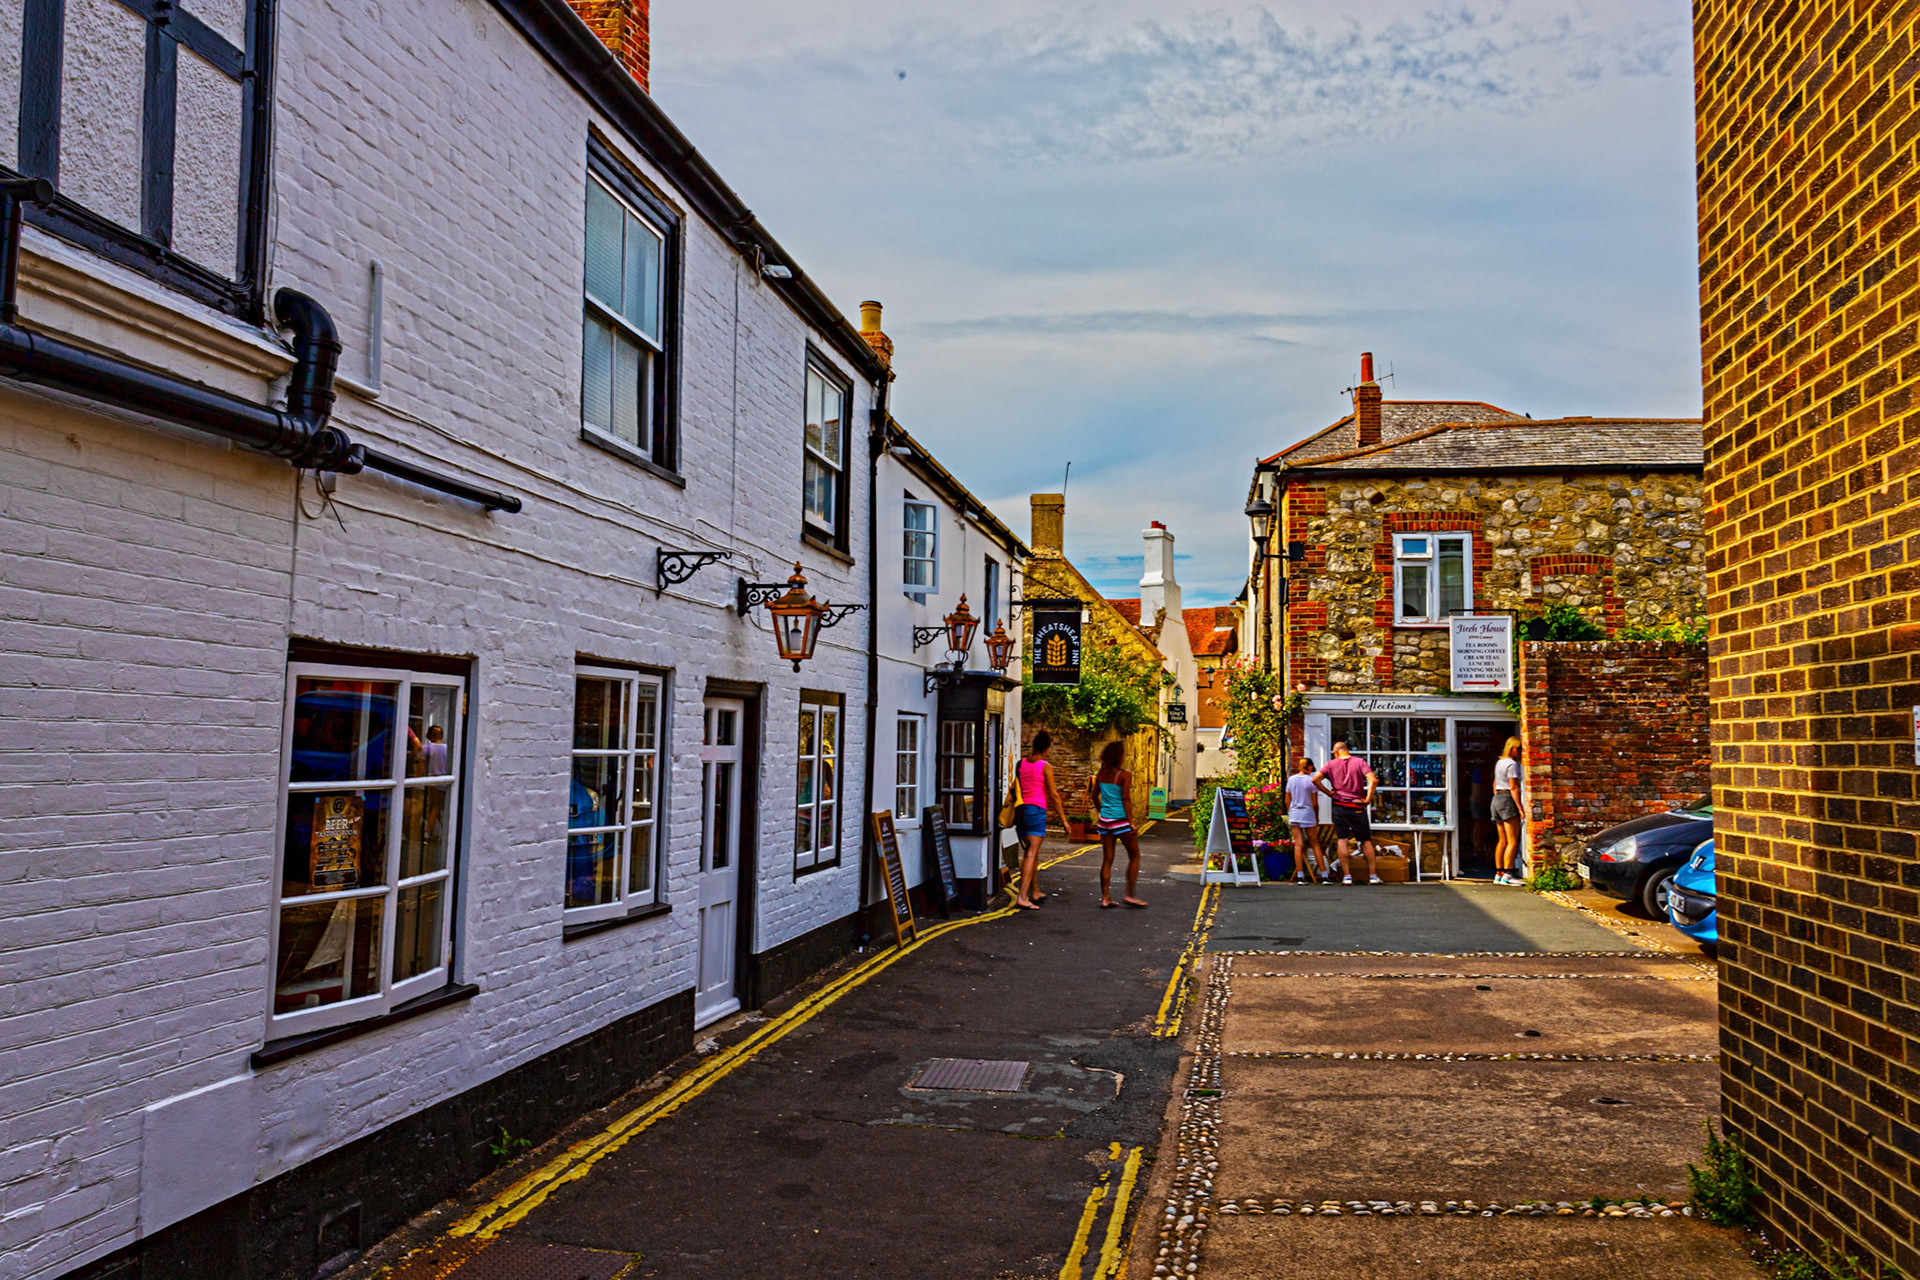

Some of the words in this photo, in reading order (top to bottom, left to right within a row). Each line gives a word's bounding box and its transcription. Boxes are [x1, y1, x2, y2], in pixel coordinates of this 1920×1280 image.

[1480, 622, 1506, 634] House
[1035, 623, 1079, 646] WHEATSHEAF
[1356, 699, 1412, 711] Reflections
[325, 819, 348, 830] BEER
